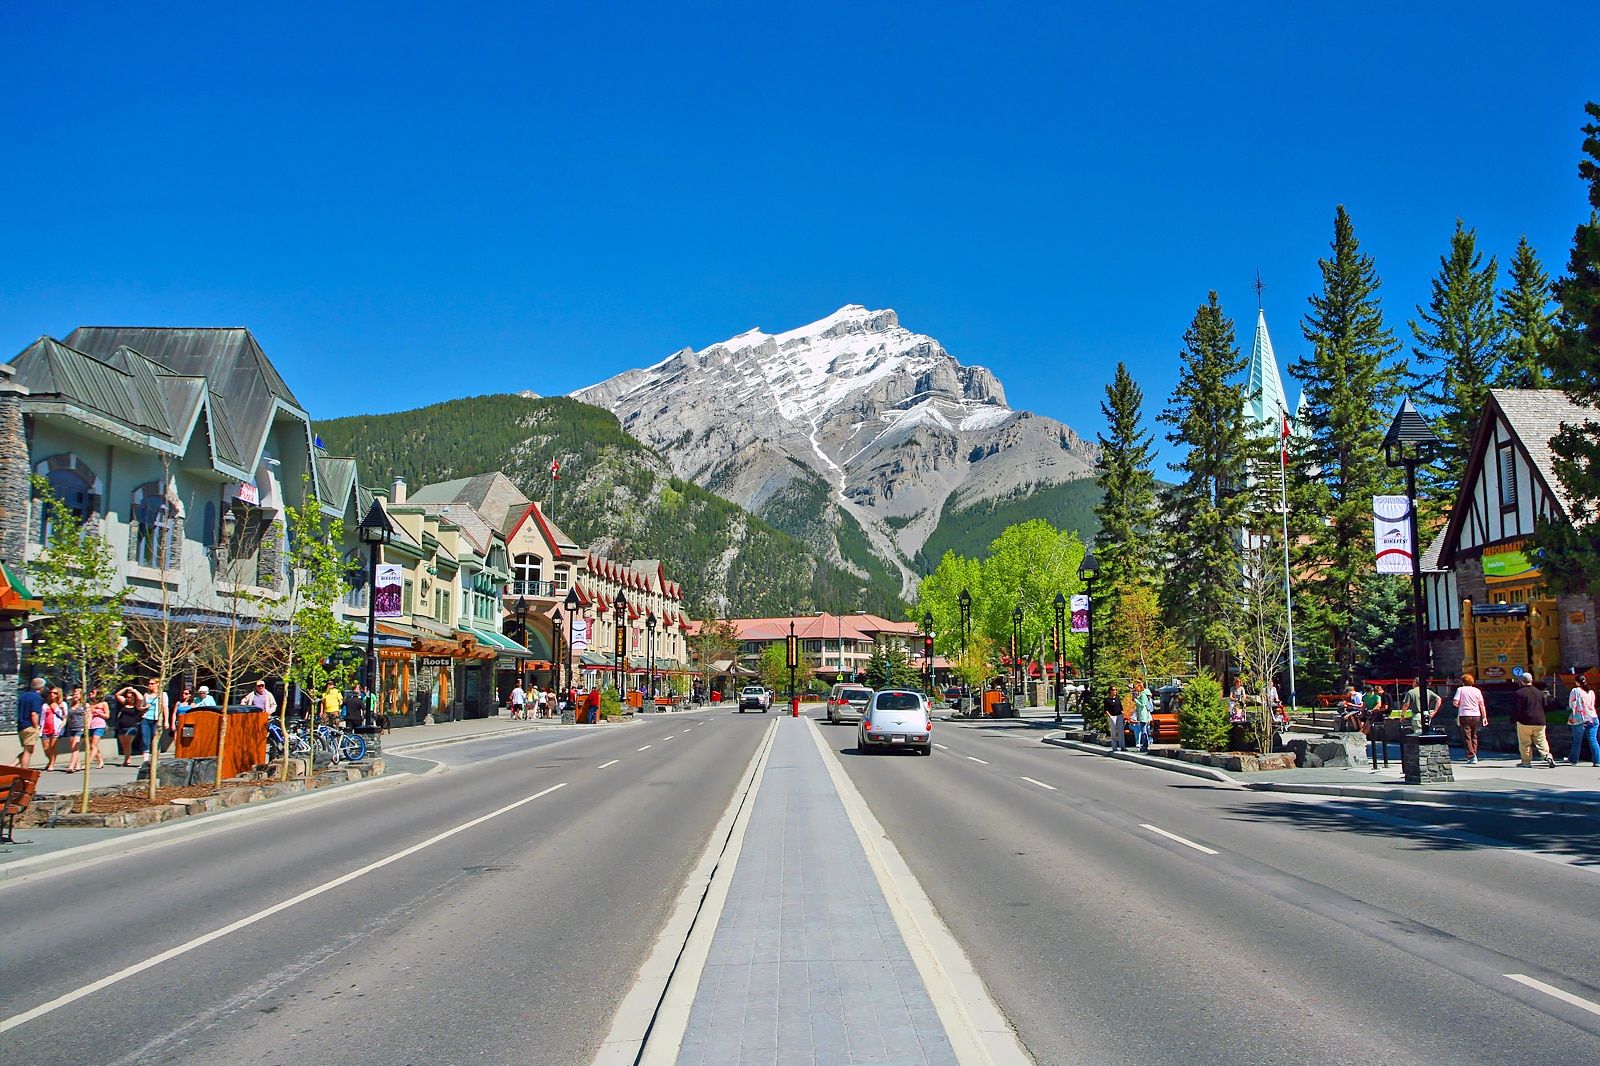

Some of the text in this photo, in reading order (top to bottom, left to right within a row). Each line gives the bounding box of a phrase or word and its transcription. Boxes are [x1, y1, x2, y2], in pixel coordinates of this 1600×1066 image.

[1483, 540, 1535, 557] INFORMATI
[1479, 625, 1523, 633] INFORMATION
[423, 657, 450, 666] Roots
